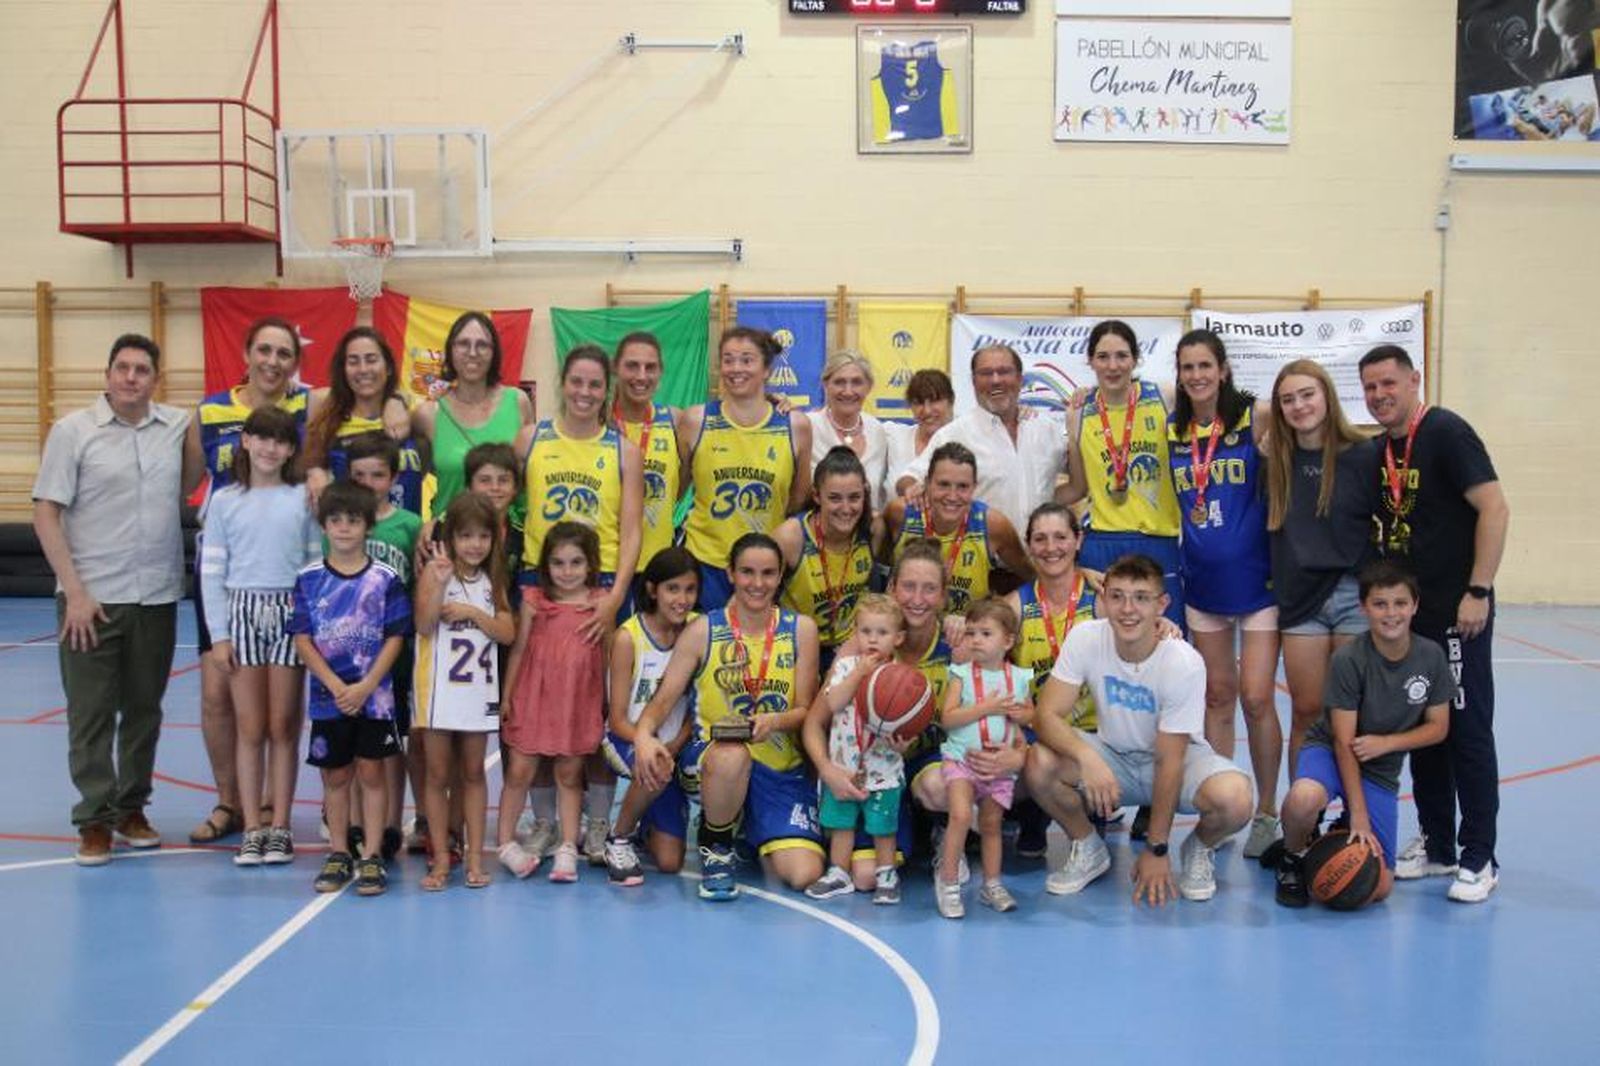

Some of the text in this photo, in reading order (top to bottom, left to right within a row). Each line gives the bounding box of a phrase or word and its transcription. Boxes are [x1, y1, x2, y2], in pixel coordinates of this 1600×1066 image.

[792, 1, 825, 11] FALTAS
[1077, 36, 1269, 62] PABELLÓN MUNICIPAL
[905, 60, 919, 89] 5
[1090, 65, 1160, 96] Chema
[449, 638, 493, 683] 24
